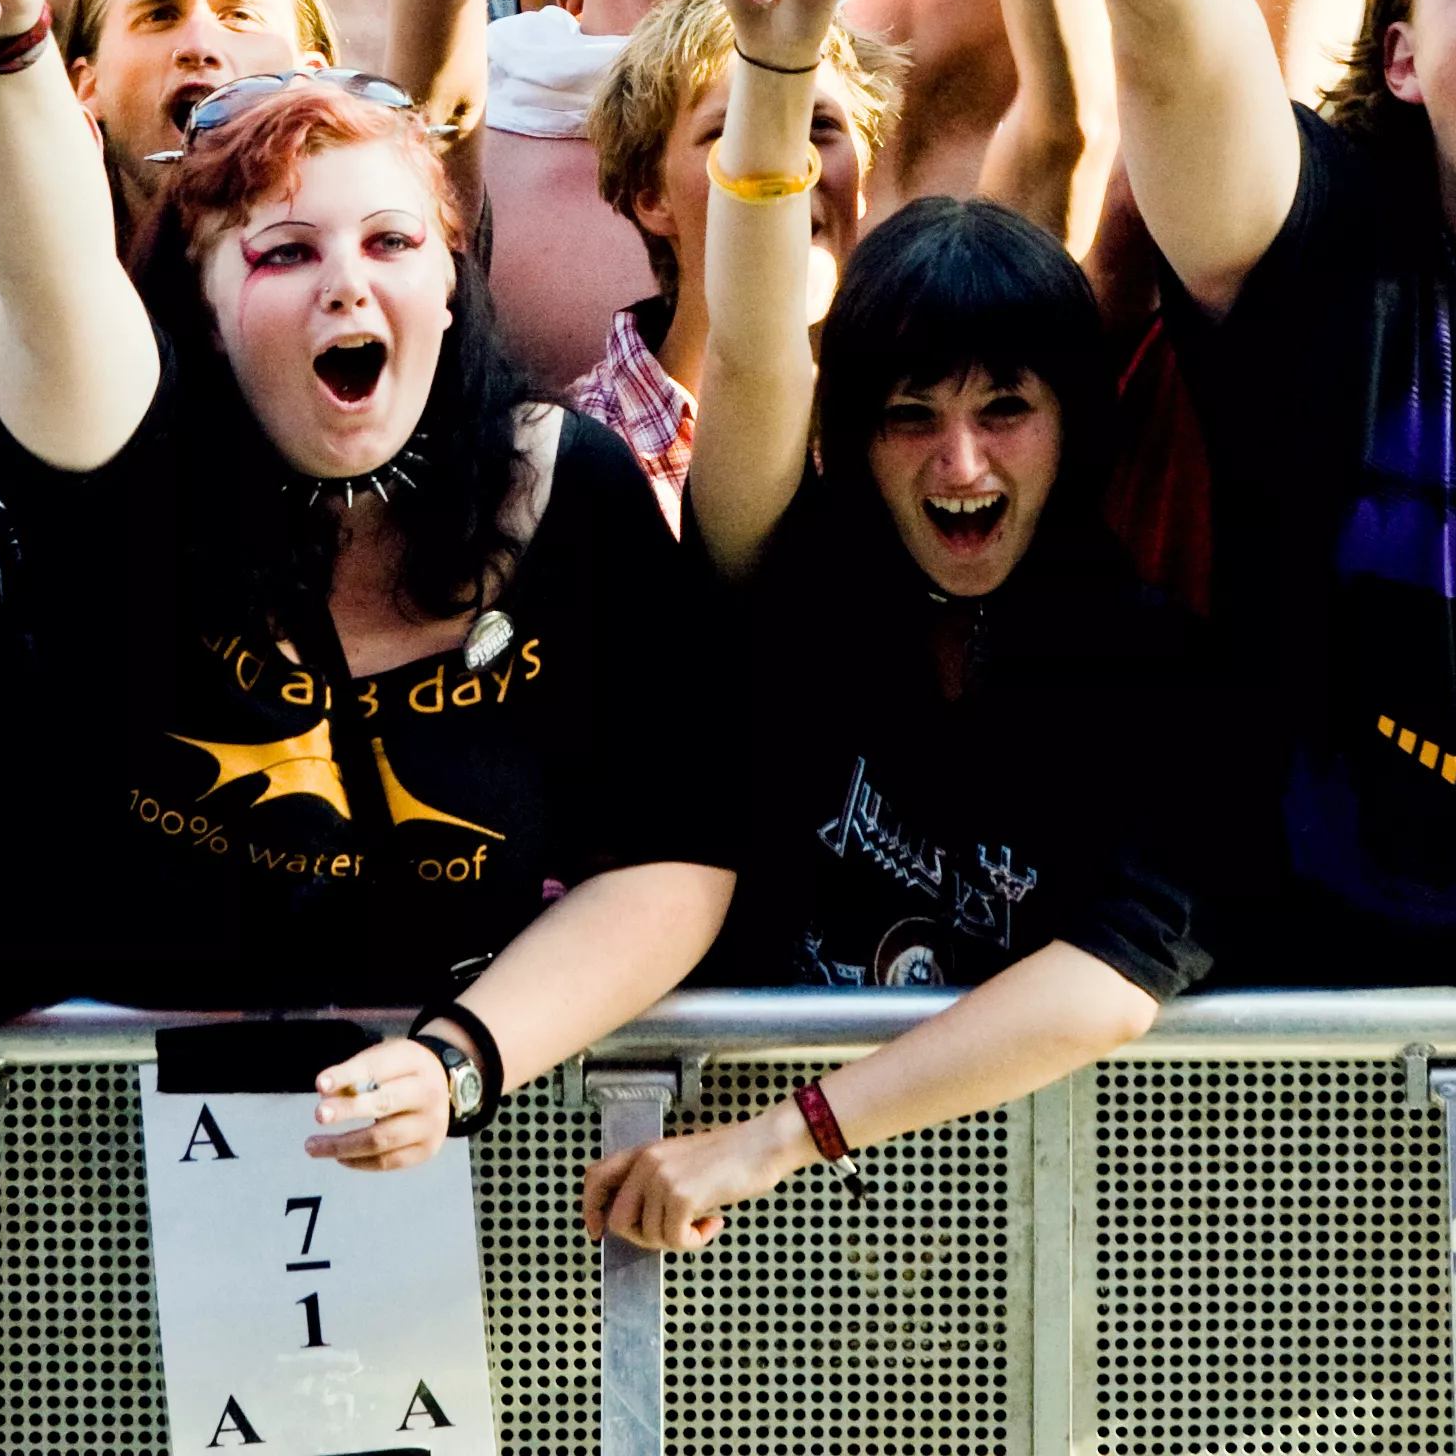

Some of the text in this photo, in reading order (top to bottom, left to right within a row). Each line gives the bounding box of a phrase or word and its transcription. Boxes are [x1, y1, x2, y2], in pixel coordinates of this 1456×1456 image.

[407, 637, 542, 714] days
[128, 788, 229, 855] 100%
[247, 842, 489, 883] wateroof
[178, 1102, 238, 1162] A
[284, 1195, 323, 1255] 7
[295, 1291, 332, 1348] 1
[205, 1378, 456, 1447] A A
